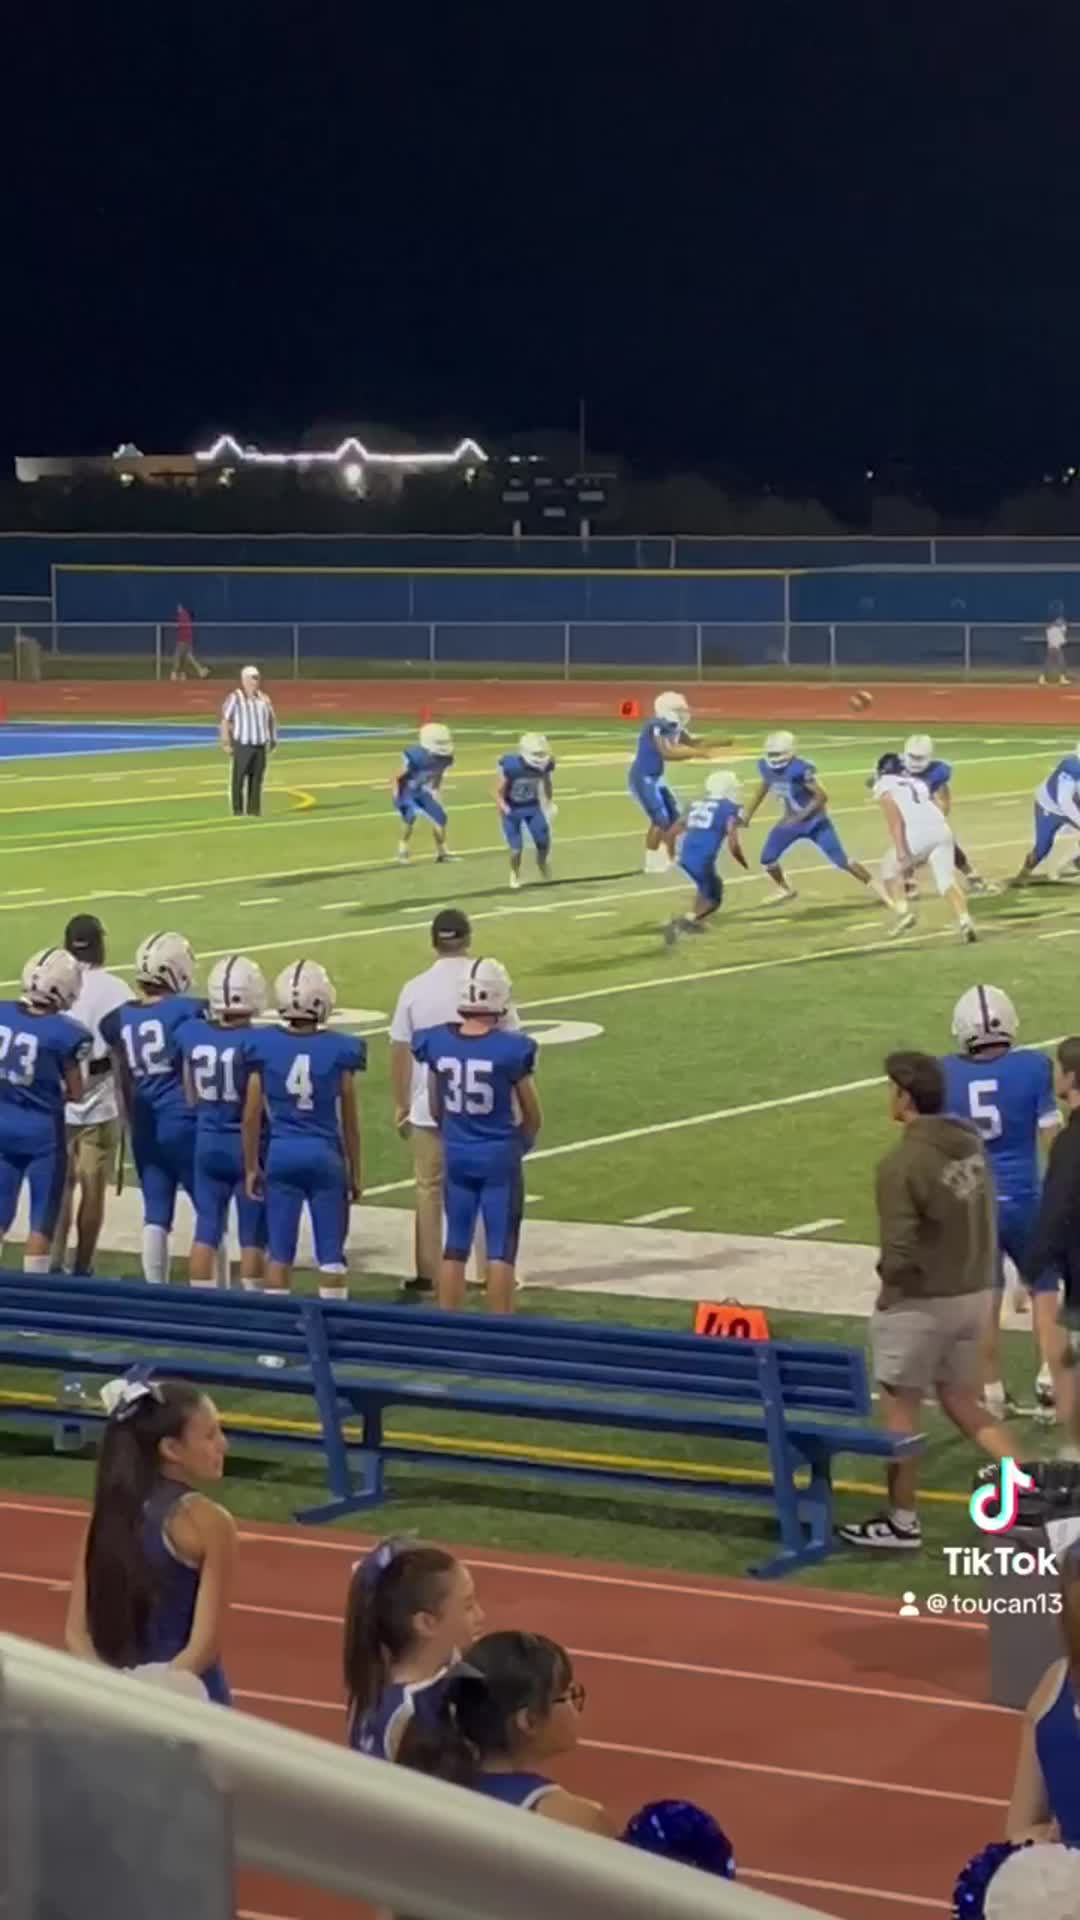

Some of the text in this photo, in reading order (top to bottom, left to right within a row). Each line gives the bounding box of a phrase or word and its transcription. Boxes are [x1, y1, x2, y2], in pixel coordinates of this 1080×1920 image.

[121, 1019, 173, 1077] 12
[191, 1044, 239, 1101] 21
[285, 1053, 314, 1111] 4
[437, 1056, 494, 1115] 35
[968, 1079, 1003, 1140] 5
